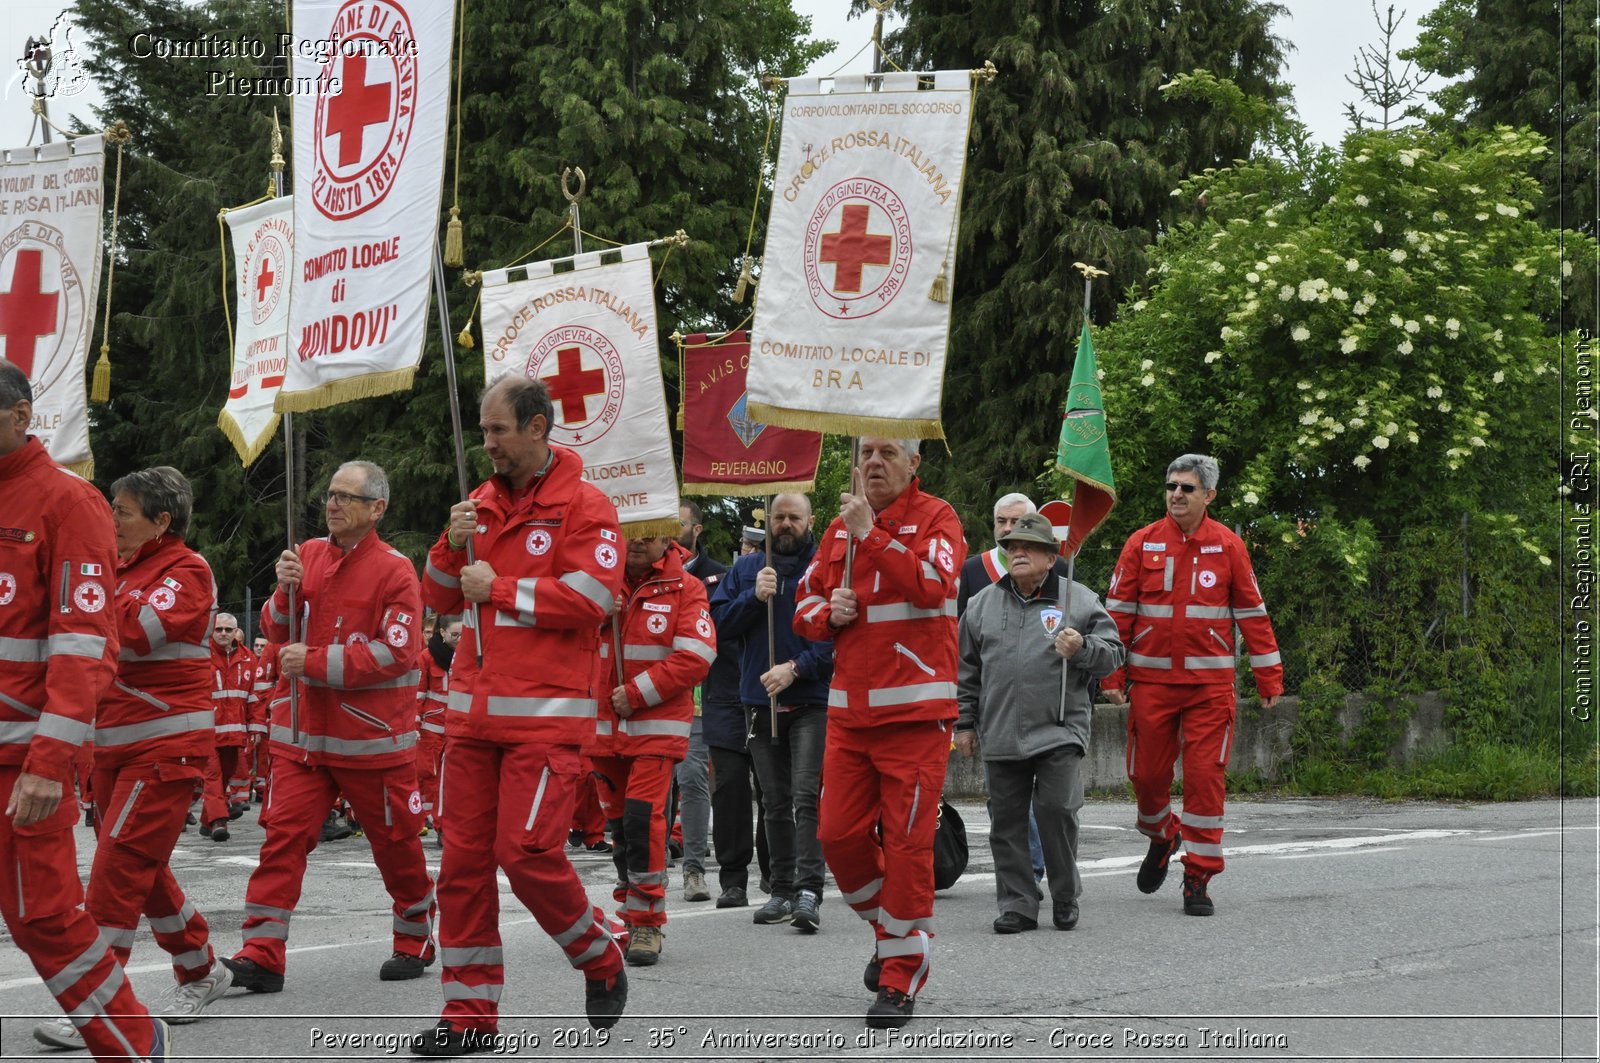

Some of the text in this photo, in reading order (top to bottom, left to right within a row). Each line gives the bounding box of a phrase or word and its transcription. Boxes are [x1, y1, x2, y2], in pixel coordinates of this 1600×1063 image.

[368, 5, 389, 33] DI
[879, 103, 900, 115] DEL
[903, 102, 962, 115] SOCCORSO
[366, 152, 397, 198] 1864
[831, 130, 890, 154] ROSSA
[893, 136, 953, 205] ITALIANA
[43, 174, 60, 190] DEL
[836, 182, 888, 204] GINEVRA
[826, 192, 836, 206] DI
[887, 198, 901, 216] 22
[37, 226, 52, 241] DI
[895, 215, 909, 274] AGOSTO
[304, 247, 347, 283] COMITATO
[352, 236, 400, 269] LOCALE
[332, 278, 346, 303] di
[878, 276, 900, 302] 1864
[491, 286, 649, 362] CROCE ROSSA ITALIANA
[538, 341, 549, 355] DI
[549, 329, 592, 347] GINEVRA
[594, 336, 607, 351] 22
[760, 340, 931, 366] COMITATO LOCALE DI
[604, 349, 622, 399] AGOSTO
[812, 368, 864, 391] BRA
[602, 402, 618, 425] 1864
[593, 462, 645, 481] LOCALE
[710, 460, 787, 476] PEVERAGNO
